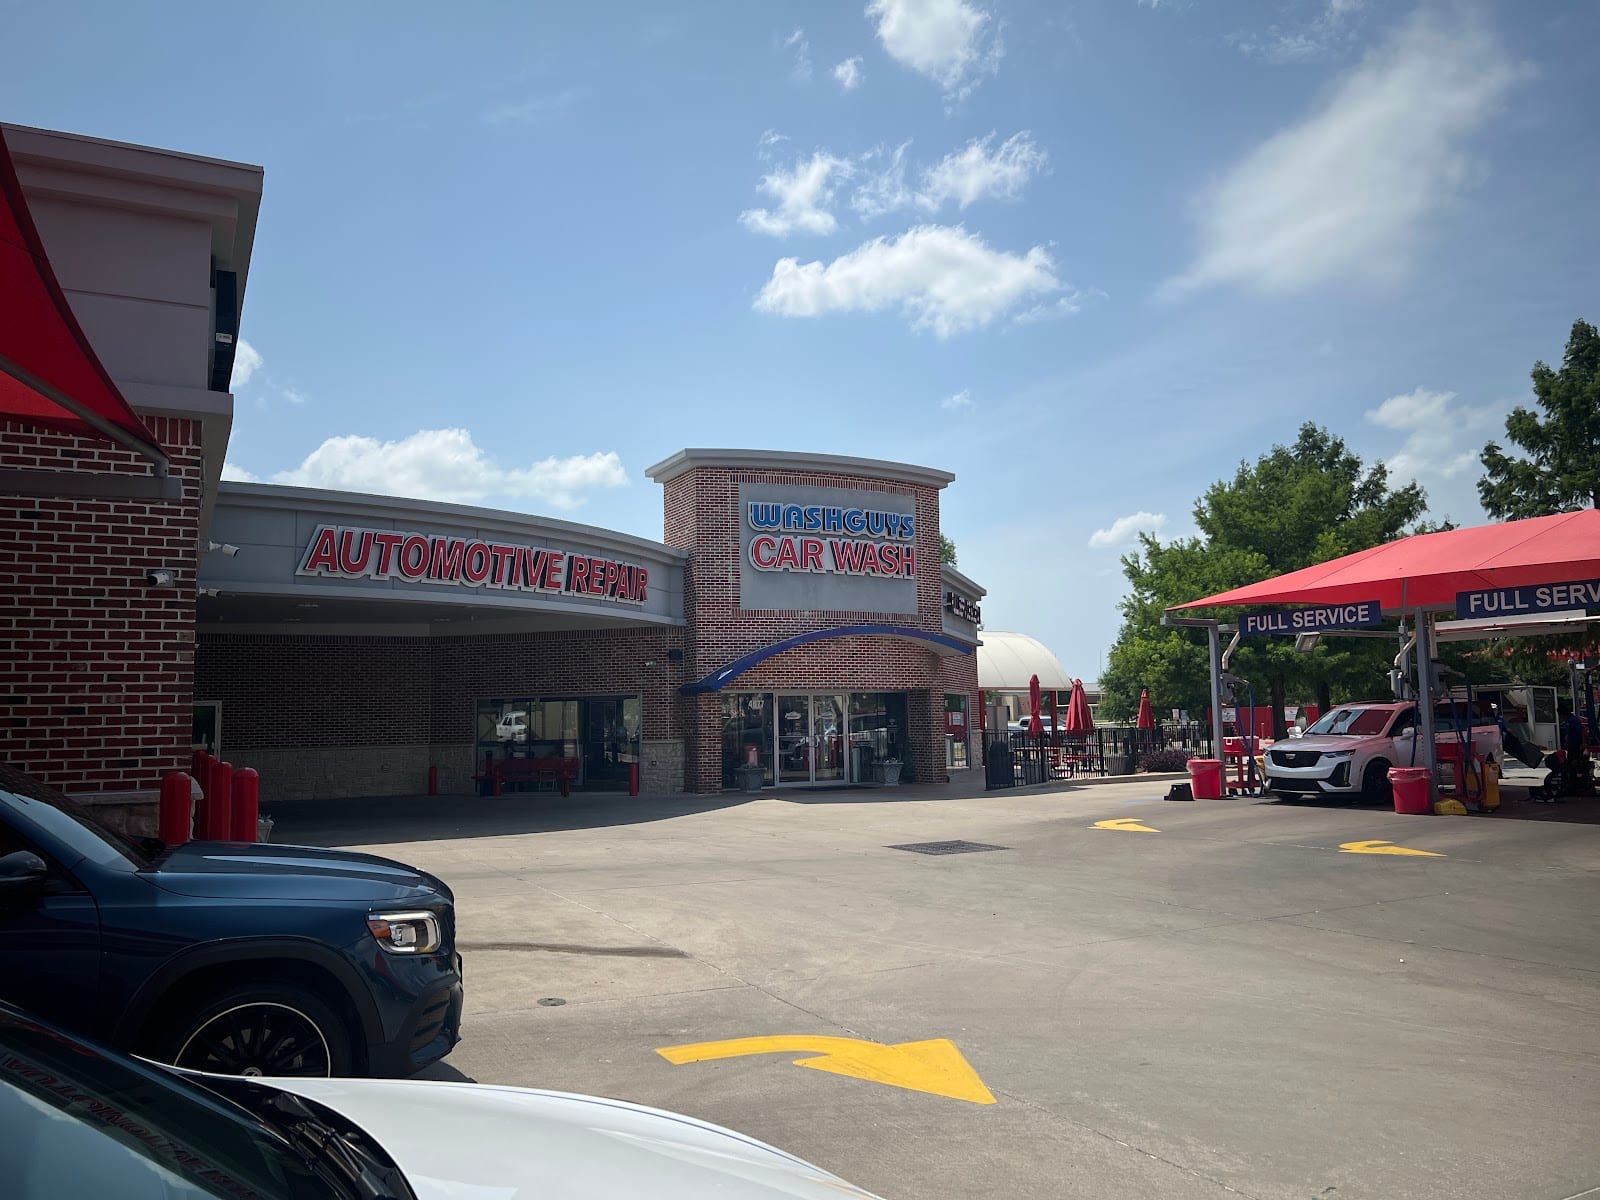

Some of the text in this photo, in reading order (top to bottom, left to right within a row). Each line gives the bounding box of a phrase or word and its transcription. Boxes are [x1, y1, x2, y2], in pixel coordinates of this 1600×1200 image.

[751, 503, 915, 537] WASHGUYS
[306, 528, 648, 601] AUTOMOTIVE REPAIR
[752, 537, 916, 576] CAR WASH
[1247, 605, 1370, 632] FULL SERVICE
[1469, 590, 1529, 613] FULL
